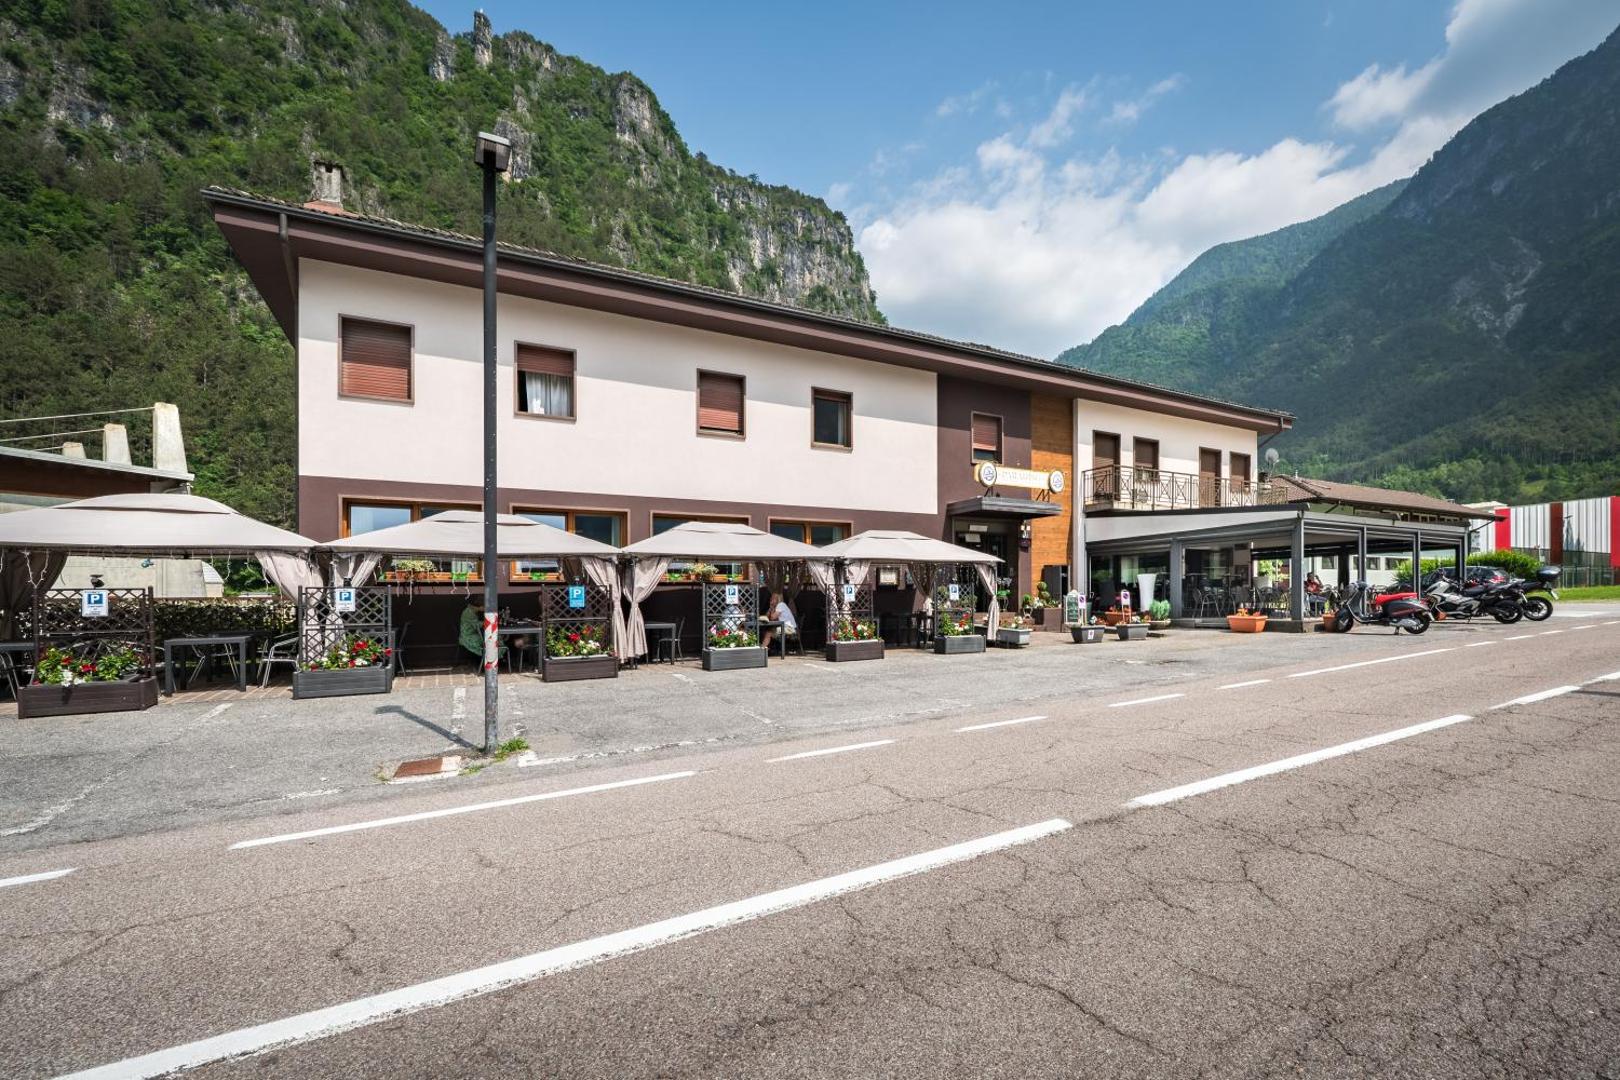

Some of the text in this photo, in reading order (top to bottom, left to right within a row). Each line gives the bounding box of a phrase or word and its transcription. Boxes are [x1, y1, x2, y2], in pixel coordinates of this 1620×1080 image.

[342, 592, 349, 600] P
[573, 589, 581, 598] P
[91, 594, 100, 603] P
